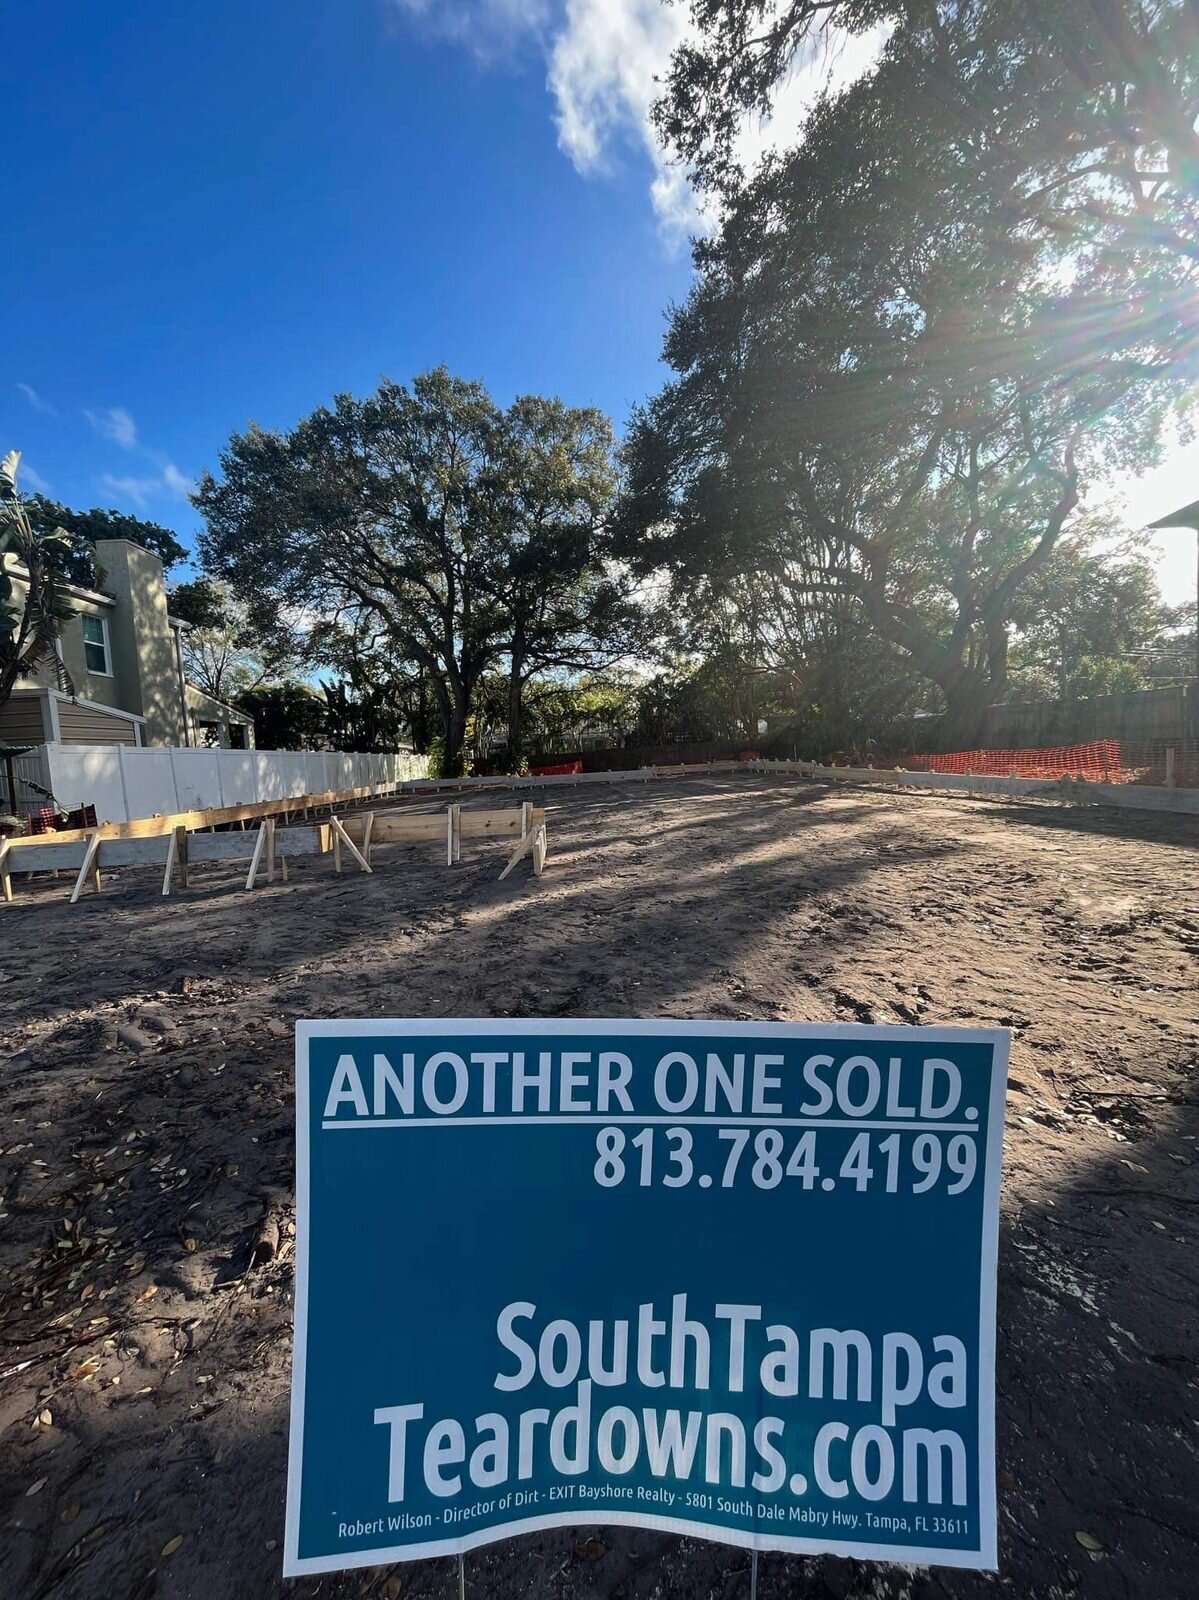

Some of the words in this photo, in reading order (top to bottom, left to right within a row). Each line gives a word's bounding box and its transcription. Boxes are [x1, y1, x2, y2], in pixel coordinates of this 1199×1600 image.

[323, 1051, 635, 1117] ANOTHER
[654, 1051, 785, 1115] ONE
[799, 1054, 979, 1120] SOLD.
[593, 1126, 978, 1195] 813.784.4199
[493, 1292, 969, 1427] SouthTampa
[373, 1378, 968, 1507] Teardowns.com
[338, 1518, 384, 1538] Robert
[388, 1513, 432, 1531] Wilson
[443, 1499, 497, 1524] Director
[498, 1493, 512, 1510] of
[515, 1490, 539, 1506] Dirt
[549, 1485, 576, 1500] EXIT
[578, 1484, 634, 1500] Bayshore
[637, 1486, 676, 1506] Realty
[686, 1492, 713, 1509] 5801
[717, 1497, 753, 1517] South
[757, 1503, 785, 1520] Dale
[789, 1506, 829, 1527] Mabry
[832, 1510, 863, 1528] Hwy.
[865, 1512, 911, 1533] Tampa,
[915, 1516, 929, 1532] FL
[932, 1518, 969, 1535] 33611
